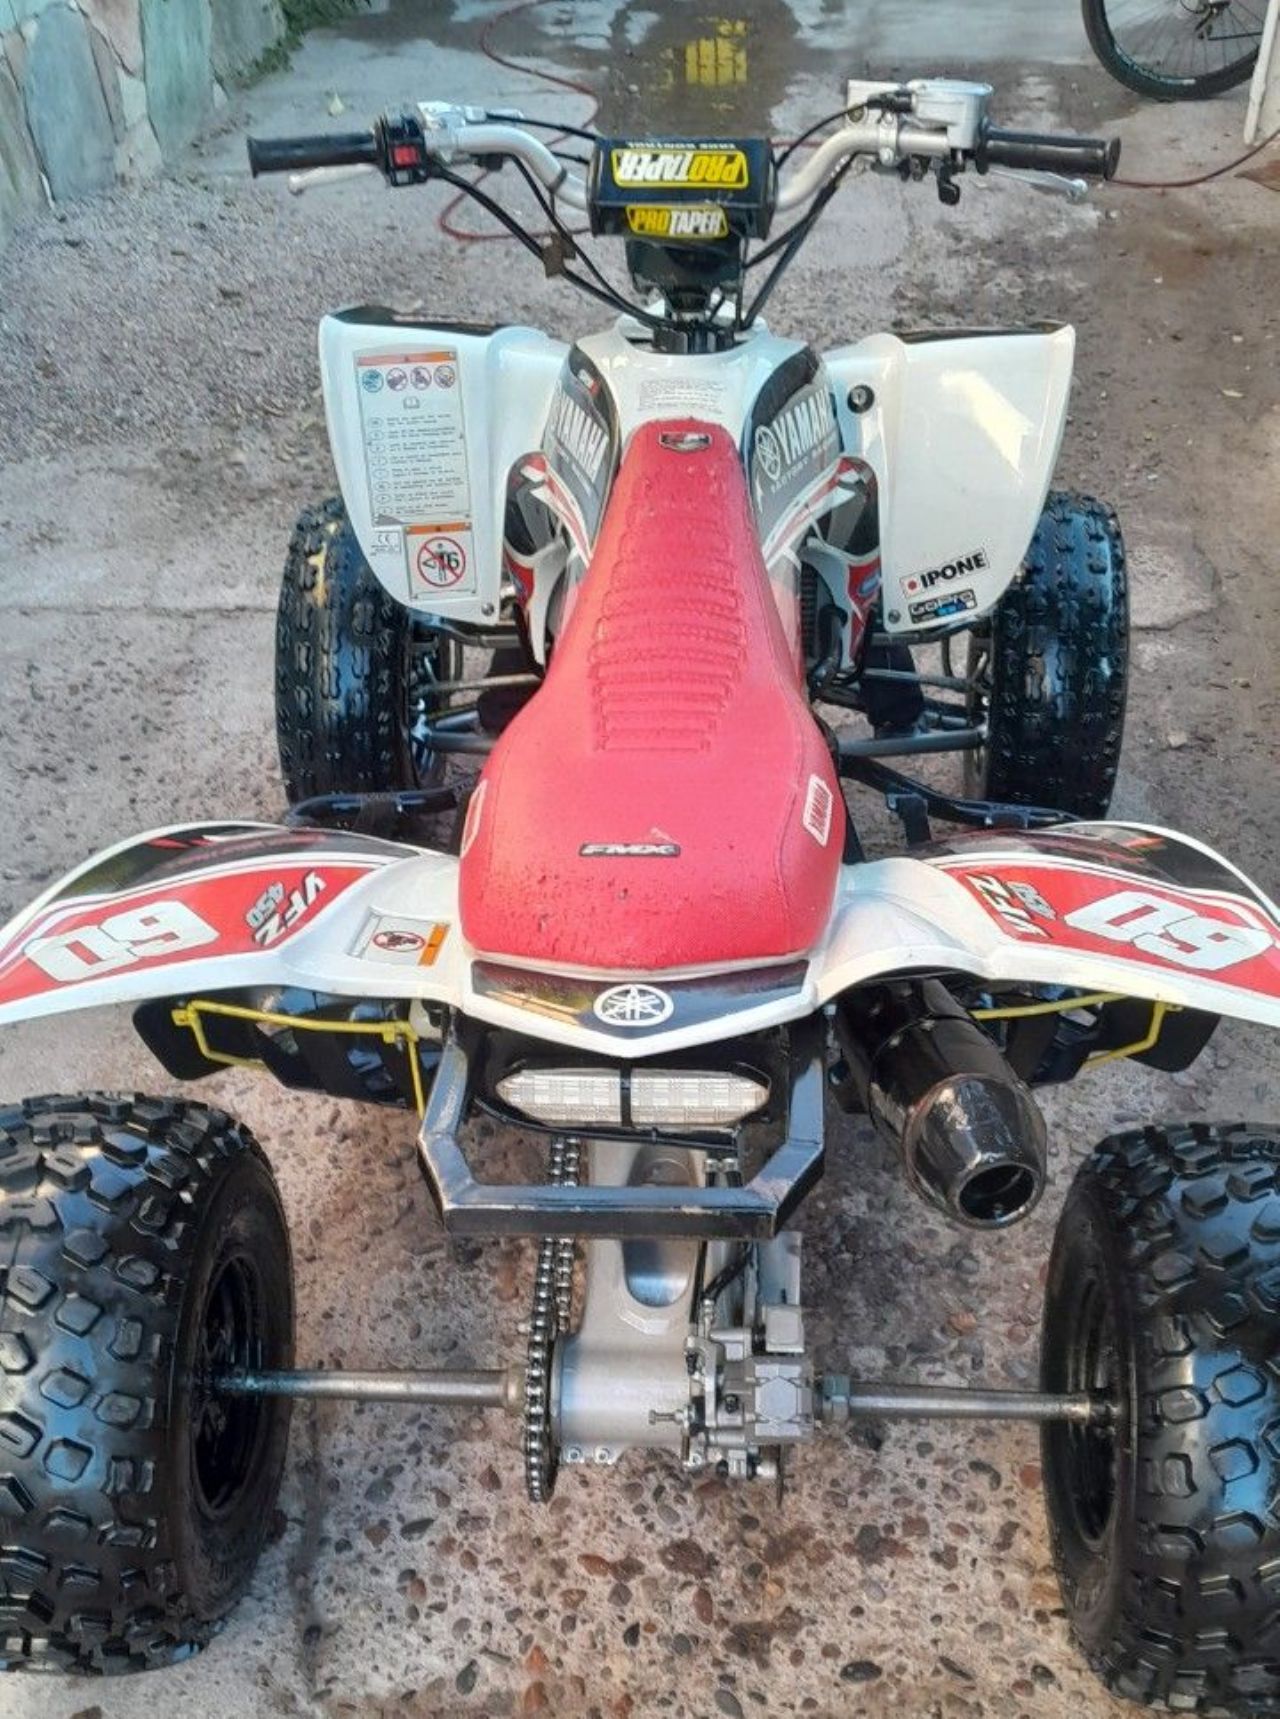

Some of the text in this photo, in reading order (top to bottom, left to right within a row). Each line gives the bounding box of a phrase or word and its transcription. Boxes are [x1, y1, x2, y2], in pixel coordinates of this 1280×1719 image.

[619, 151, 741, 182] PROTAPER
[634, 209, 722, 235] PROTAPER
[920, 552, 987, 589] IPONE
